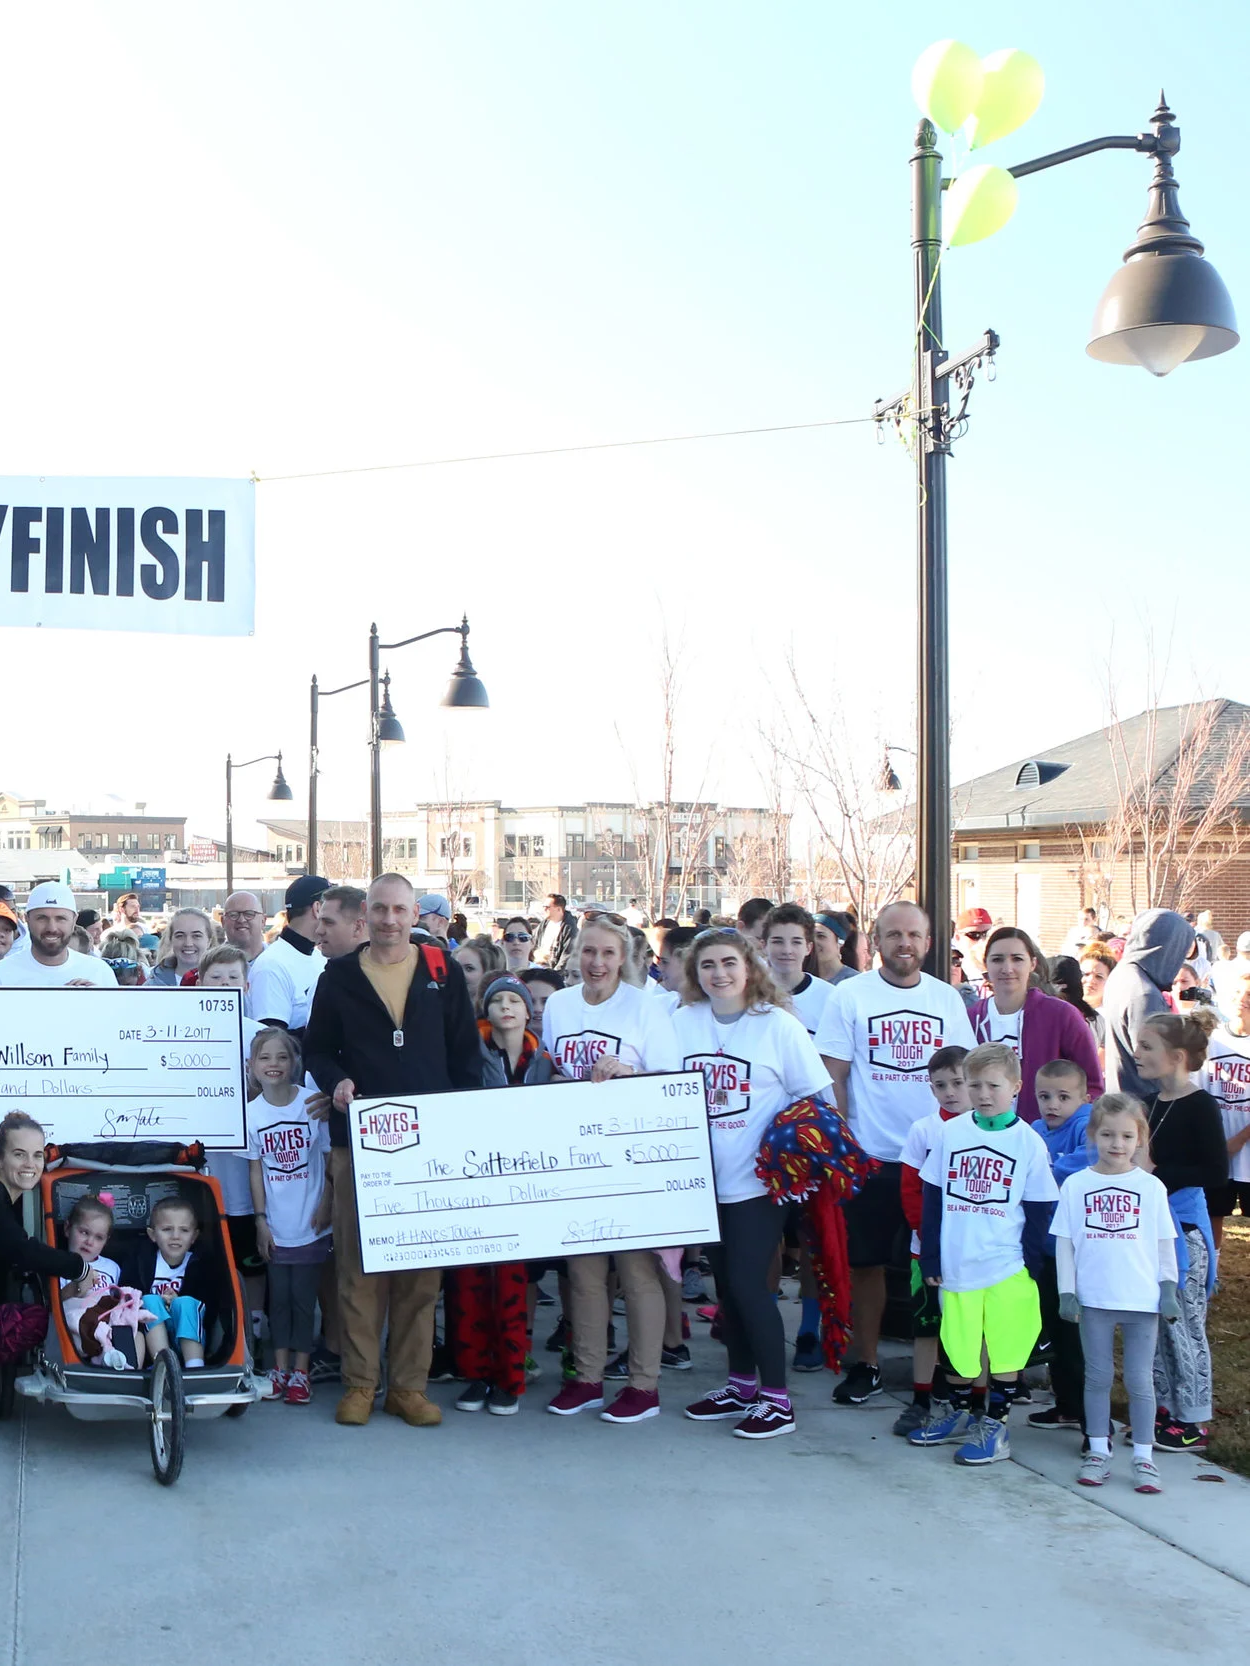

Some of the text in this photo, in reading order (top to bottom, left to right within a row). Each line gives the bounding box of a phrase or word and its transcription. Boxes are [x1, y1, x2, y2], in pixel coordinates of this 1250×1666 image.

[198, 1000, 235, 1012] 10735
[119, 1030, 142, 1040] DATE
[882, 1020, 932, 1045] HAYES
[892, 1045, 923, 1060] TOUGH
[63, 1047, 110, 1074] Family
[884, 1074, 900, 1082] PART
[902, 1074, 910, 1082] OF
[912, 1074, 924, 1082] THE
[42, 1079, 92, 1095] Dollars
[197, 1086, 235, 1098] DOLLARS
[662, 1082, 700, 1098] 10735
[579, 1124, 603, 1136] DATE
[378, 1132, 403, 1147] TOUGH
[274, 1150, 300, 1164] TOUGH
[423, 1158, 454, 1178] The
[568, 1146, 607, 1167] Fam
[666, 1177, 706, 1192] DOLLARS
[966, 1178, 992, 1194] TOUGH
[374, 1196, 405, 1214] Five
[509, 1182, 561, 1202] Dollars
[1101, 1212, 1125, 1223] TOUGH
[368, 1237, 395, 1246] MEMO
